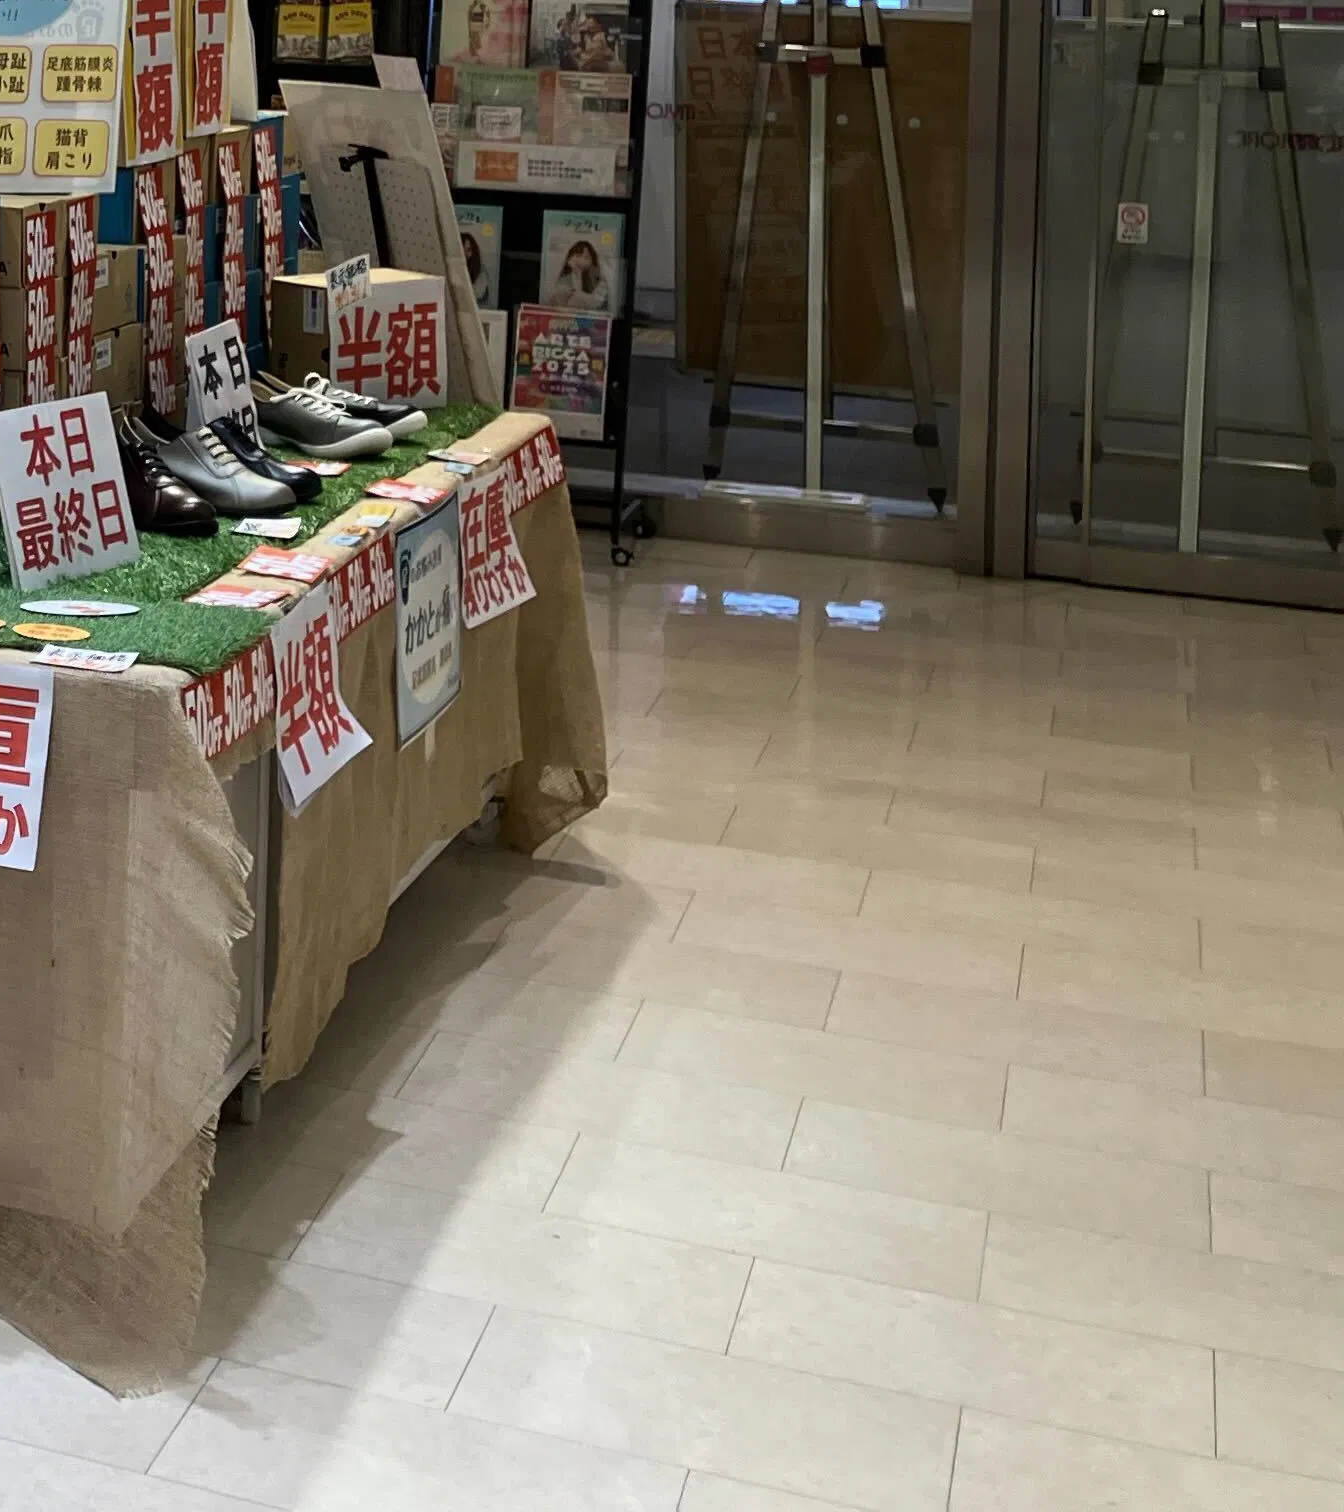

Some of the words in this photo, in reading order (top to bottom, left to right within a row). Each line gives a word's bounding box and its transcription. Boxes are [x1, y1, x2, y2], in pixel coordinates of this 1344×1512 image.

[46, 56, 114, 73] 足底筋膜炎
[44, 152, 93, 171] 肩こり
[55, 128, 89, 147] 猫背
[335, 301, 441, 400] 半額
[19, 407, 95, 487] 本日
[16, 479, 129, 573] 最終日
[462, 476, 513, 571] 在庫
[280, 613, 354, 776] 半額
